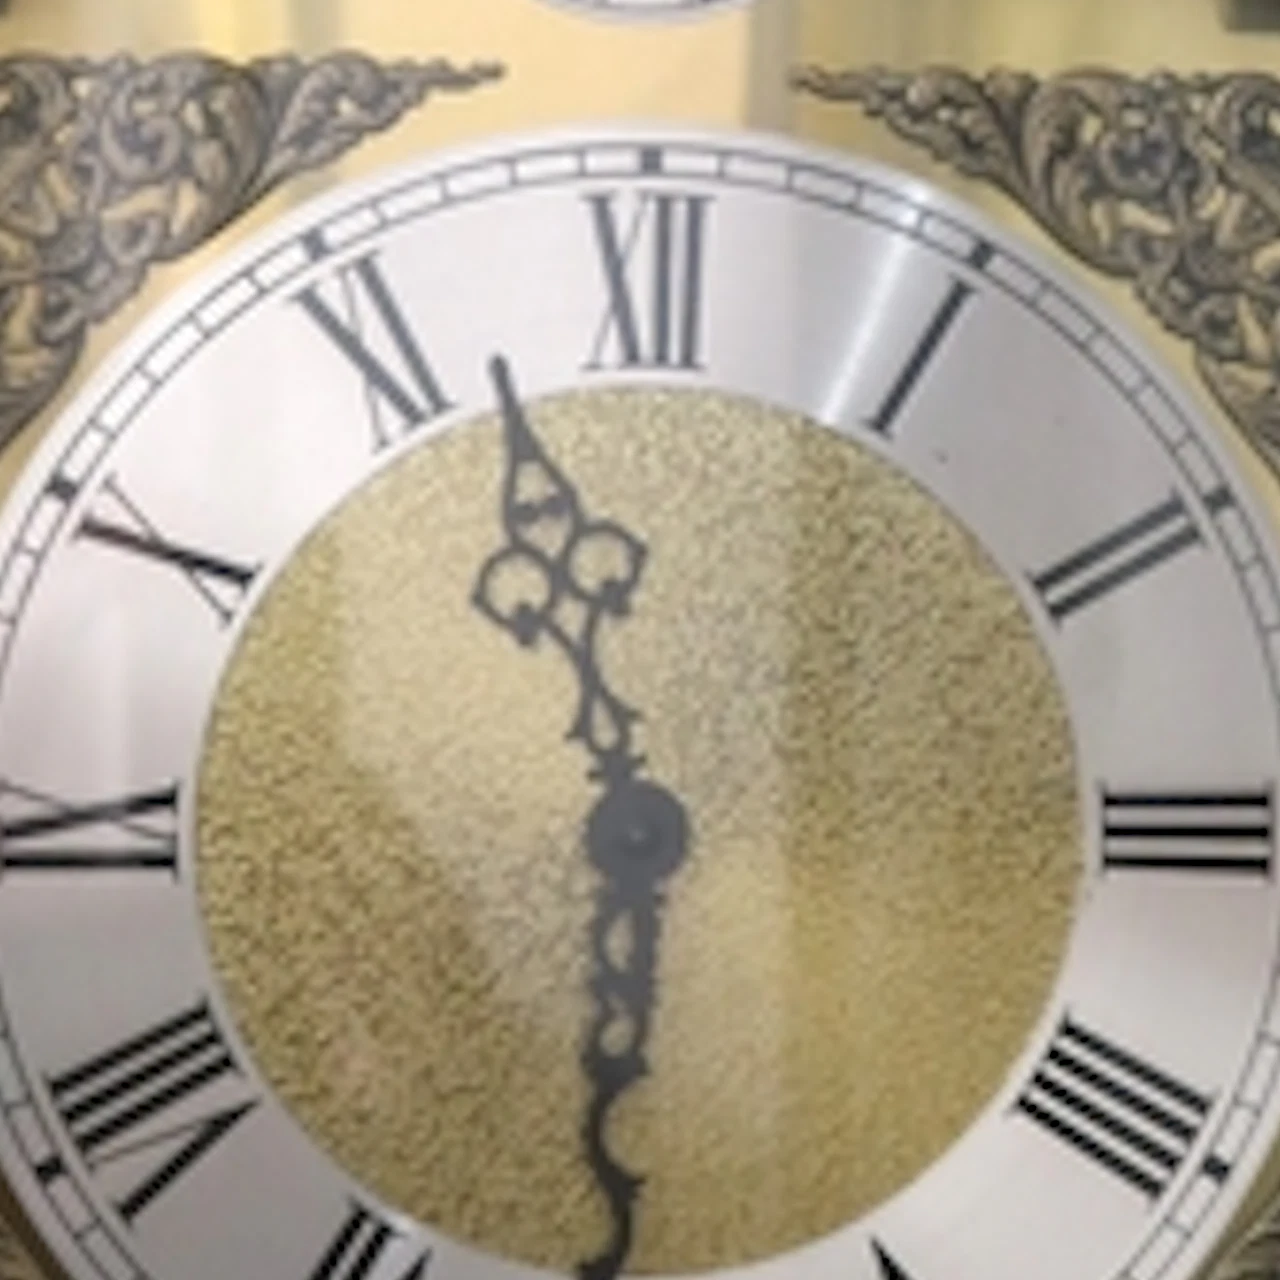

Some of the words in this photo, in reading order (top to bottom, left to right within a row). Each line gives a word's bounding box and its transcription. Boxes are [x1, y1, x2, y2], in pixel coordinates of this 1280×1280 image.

[293, 250, 457, 451] XI
[578, 190, 718, 372] XII
[863, 277, 979, 435] I
[73, 473, 258, 626] X
[1030, 495, 1207, 626] II
[1099, 780, 1276, 875] III
[48, 999, 261, 1224] VIII
[1012, 1013, 1215, 1202] IIII
